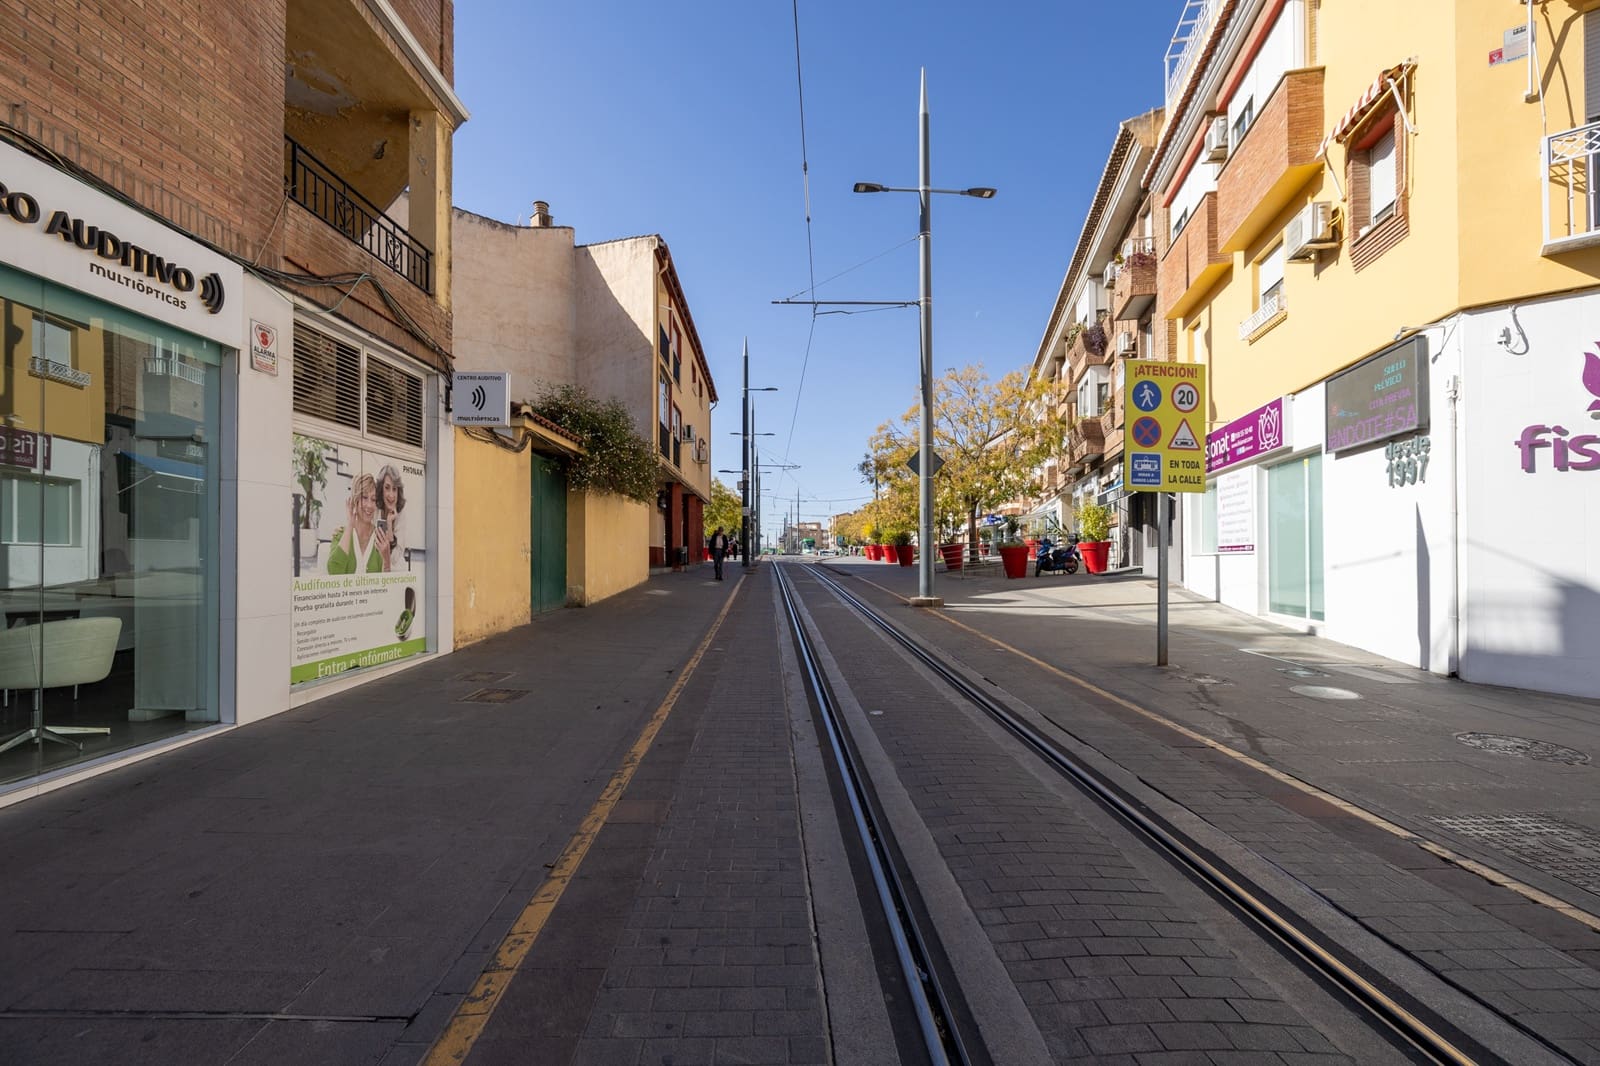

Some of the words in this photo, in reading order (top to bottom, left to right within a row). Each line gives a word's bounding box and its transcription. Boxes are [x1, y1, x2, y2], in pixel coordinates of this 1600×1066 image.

[44, 210, 195, 292] AUDITIVO
[1134, 364, 1198, 378] ¡ATENCIÓN!
[1178, 390, 1194, 405] 20
[1385, 435, 1431, 461] desde
[1514, 424, 1600, 473] fis
[1169, 460, 1179, 469] EN
[1181, 460, 1200, 469] TODA
[1386, 454, 1429, 488] 1997
[1168, 474, 1178, 484] LA
[1180, 475, 1201, 484] CALLE
[293, 578, 340, 591] Audífonos
[343, 578, 352, 588] de
[356, 576, 380, 587] última
[381, 575, 417, 587] generación
[294, 604, 313, 612] Prueba
[315, 601, 335, 611] gratuita
[318, 662, 347, 678] Entra
[360, 646, 403, 667] infórmate
